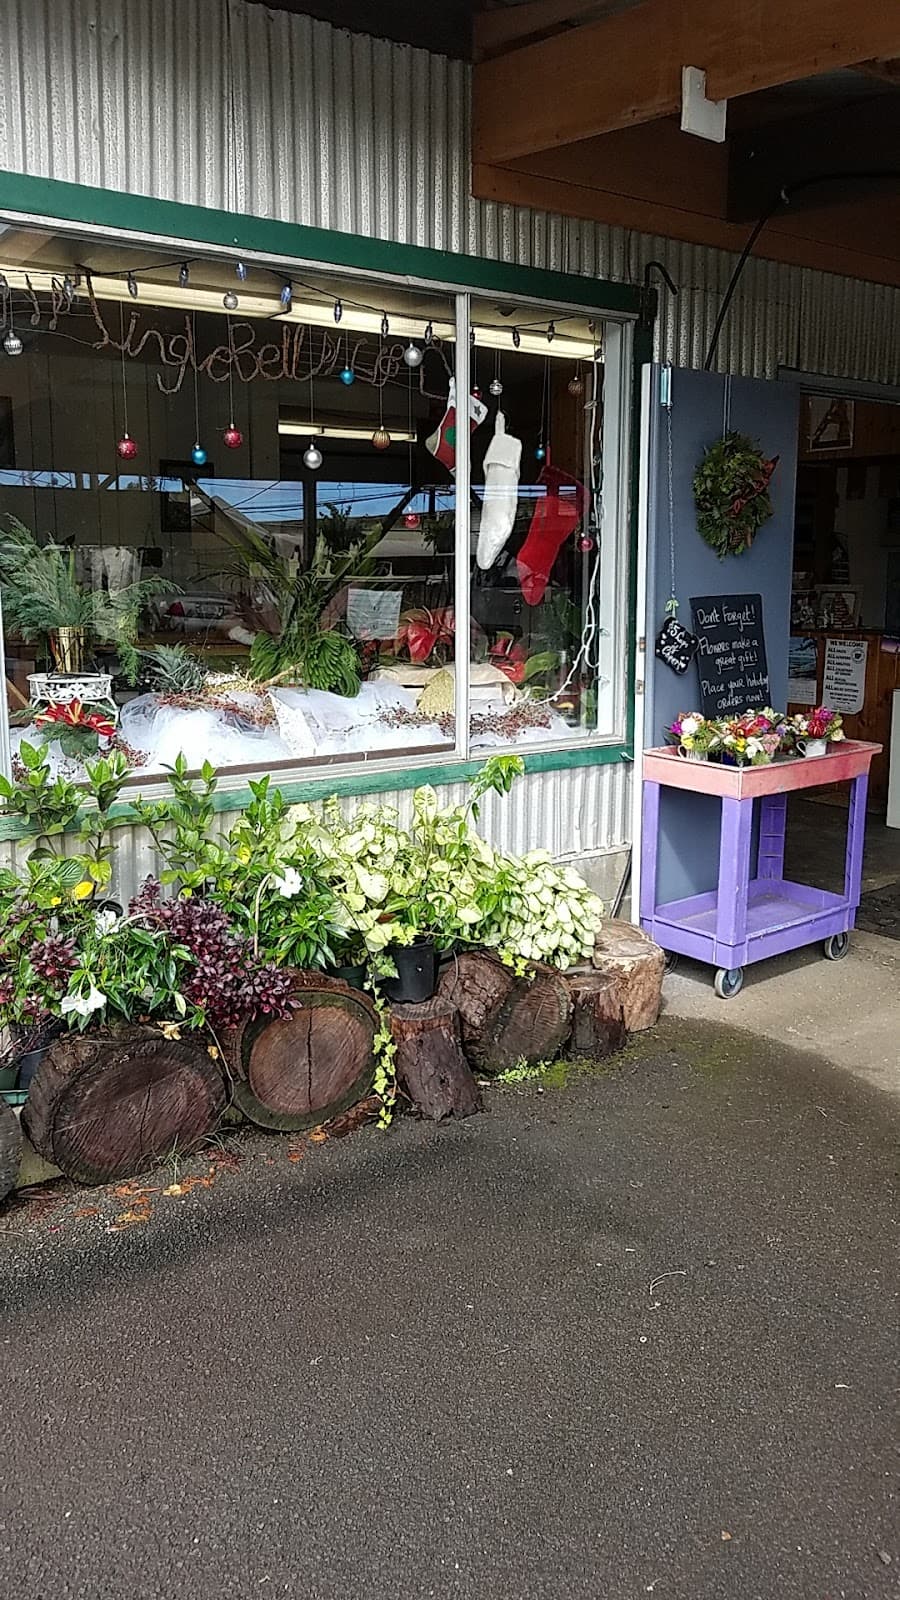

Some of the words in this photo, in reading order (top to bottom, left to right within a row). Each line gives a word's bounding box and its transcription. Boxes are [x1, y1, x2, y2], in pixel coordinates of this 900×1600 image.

[722, 603, 756, 632] Forget!
[732, 636, 751, 650] make
[752, 639, 759, 647] a
[738, 650, 758, 672] gift!
[701, 678, 726, 698] Place
[728, 678, 746, 699] your
[746, 671, 770, 693] holiday
[717, 693, 743, 710] orders
[745, 689, 764, 704] now!
